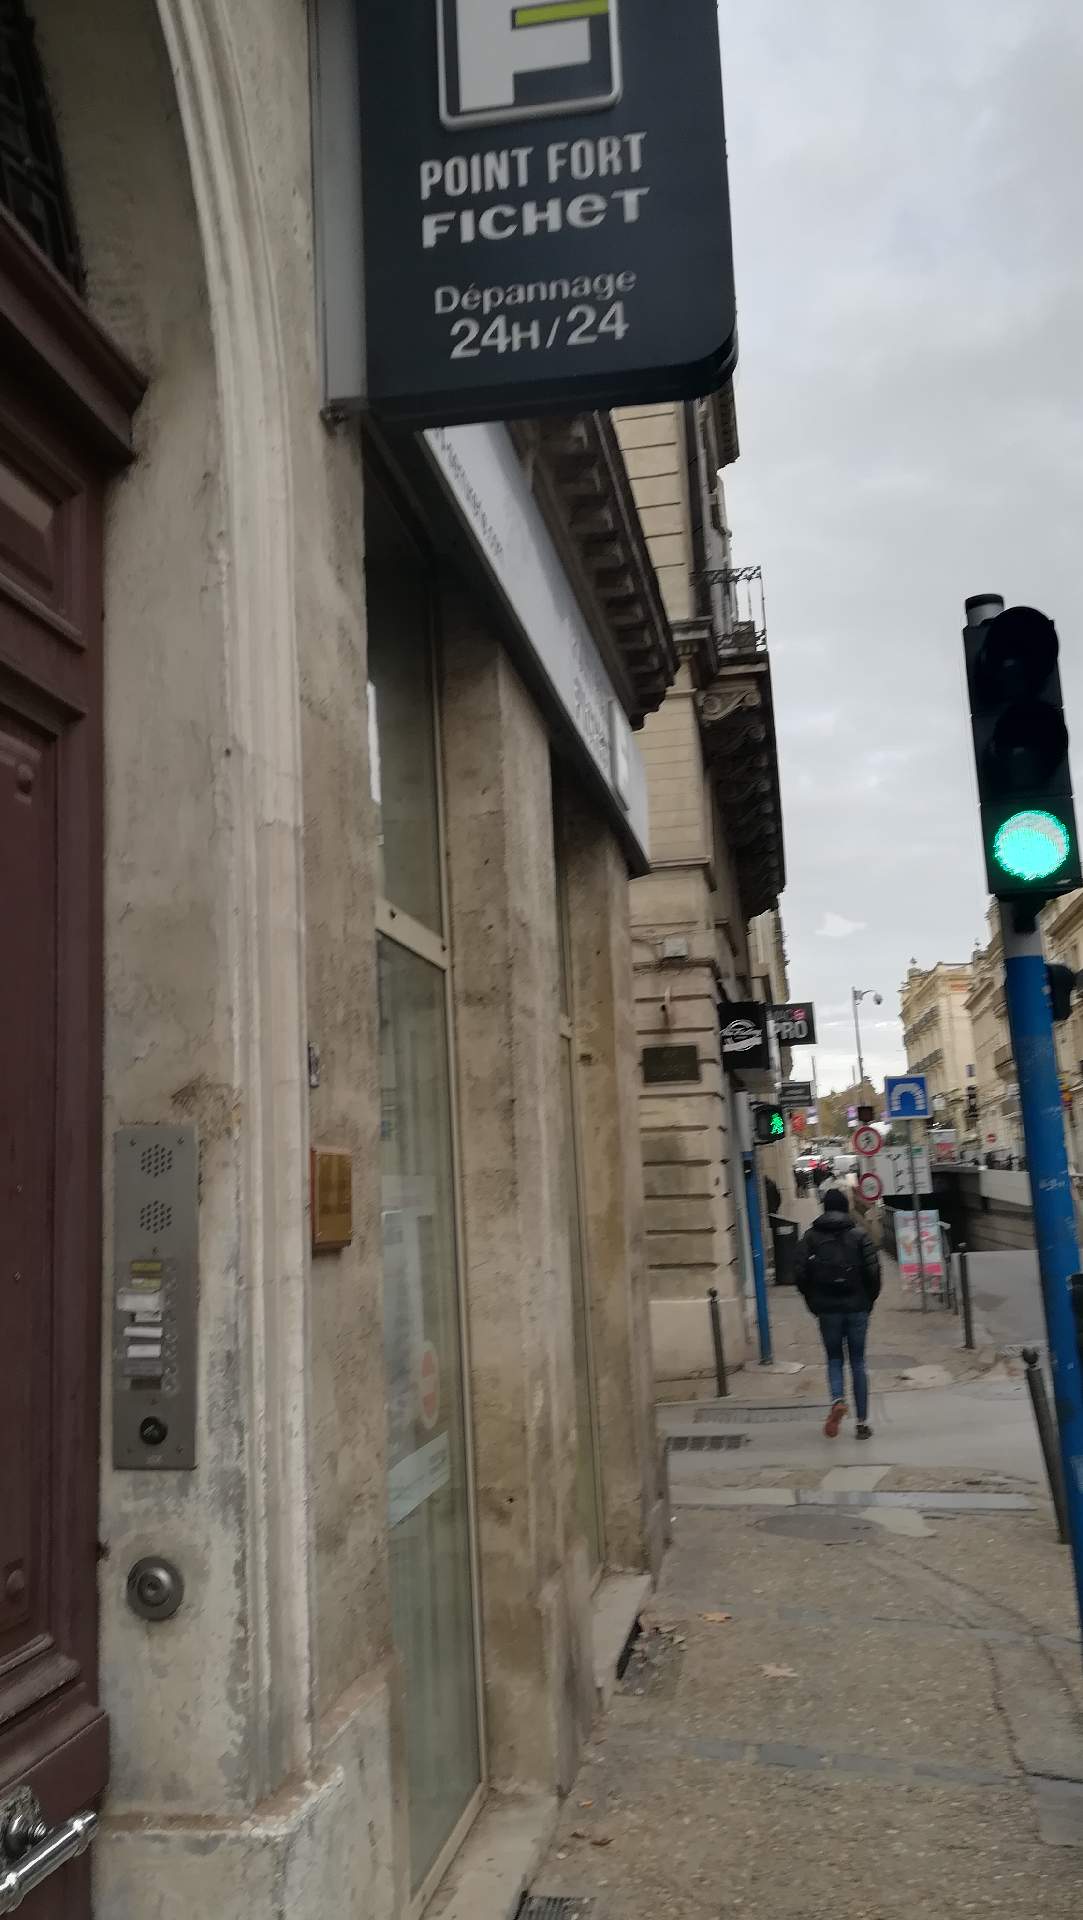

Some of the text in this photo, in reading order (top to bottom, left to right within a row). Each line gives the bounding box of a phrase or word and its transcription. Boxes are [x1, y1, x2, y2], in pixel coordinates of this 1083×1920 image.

[420, 132, 647, 200] POINT FORT
[435, 271, 637, 314] Dépannage
[450, 302, 629, 360] 24H/24
